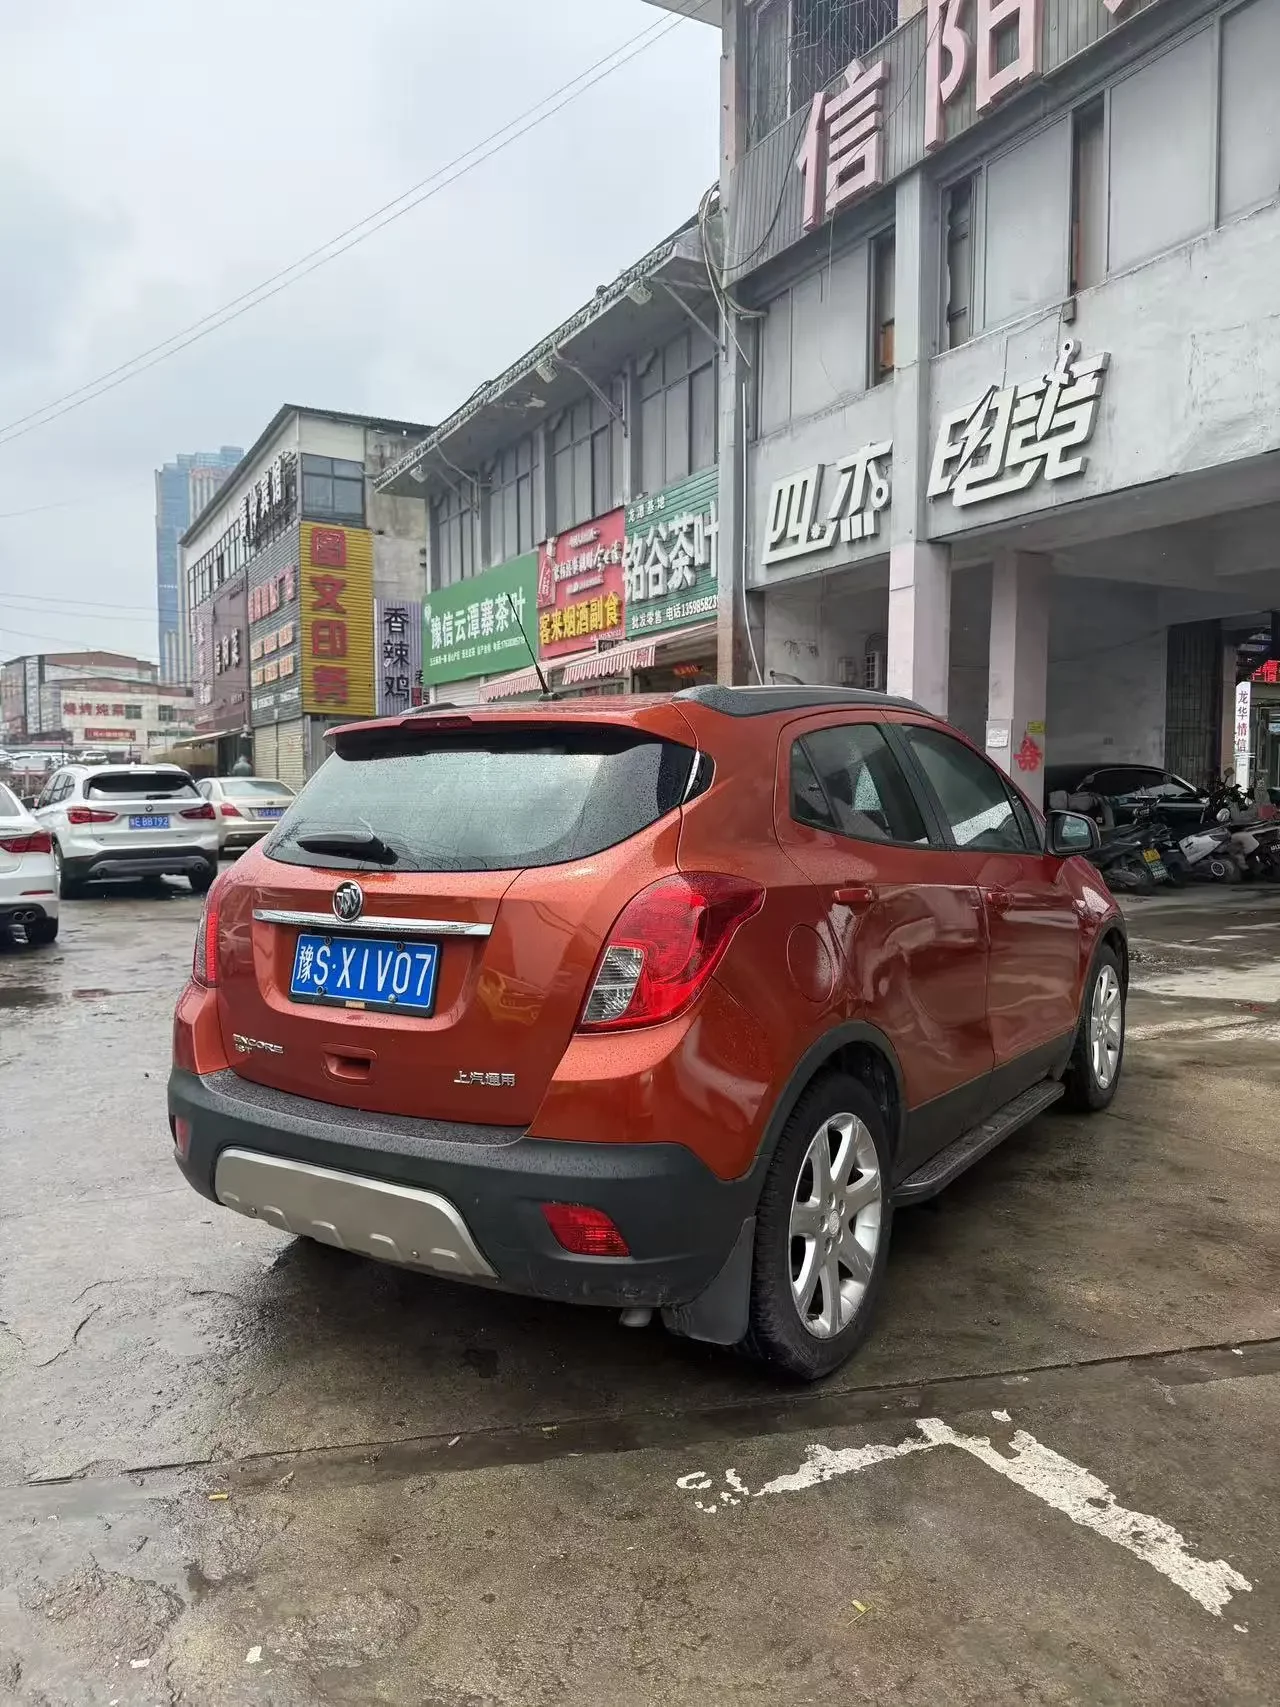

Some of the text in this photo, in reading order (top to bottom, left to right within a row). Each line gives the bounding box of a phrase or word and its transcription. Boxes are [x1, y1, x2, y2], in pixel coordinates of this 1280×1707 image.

[540, 591, 621, 647] 客来烟酒副食
[384, 607, 410, 701] 香辣鸡
[232, 1033, 284, 1054] ENCORE
[454, 1070, 516, 1087] 上汽通用
